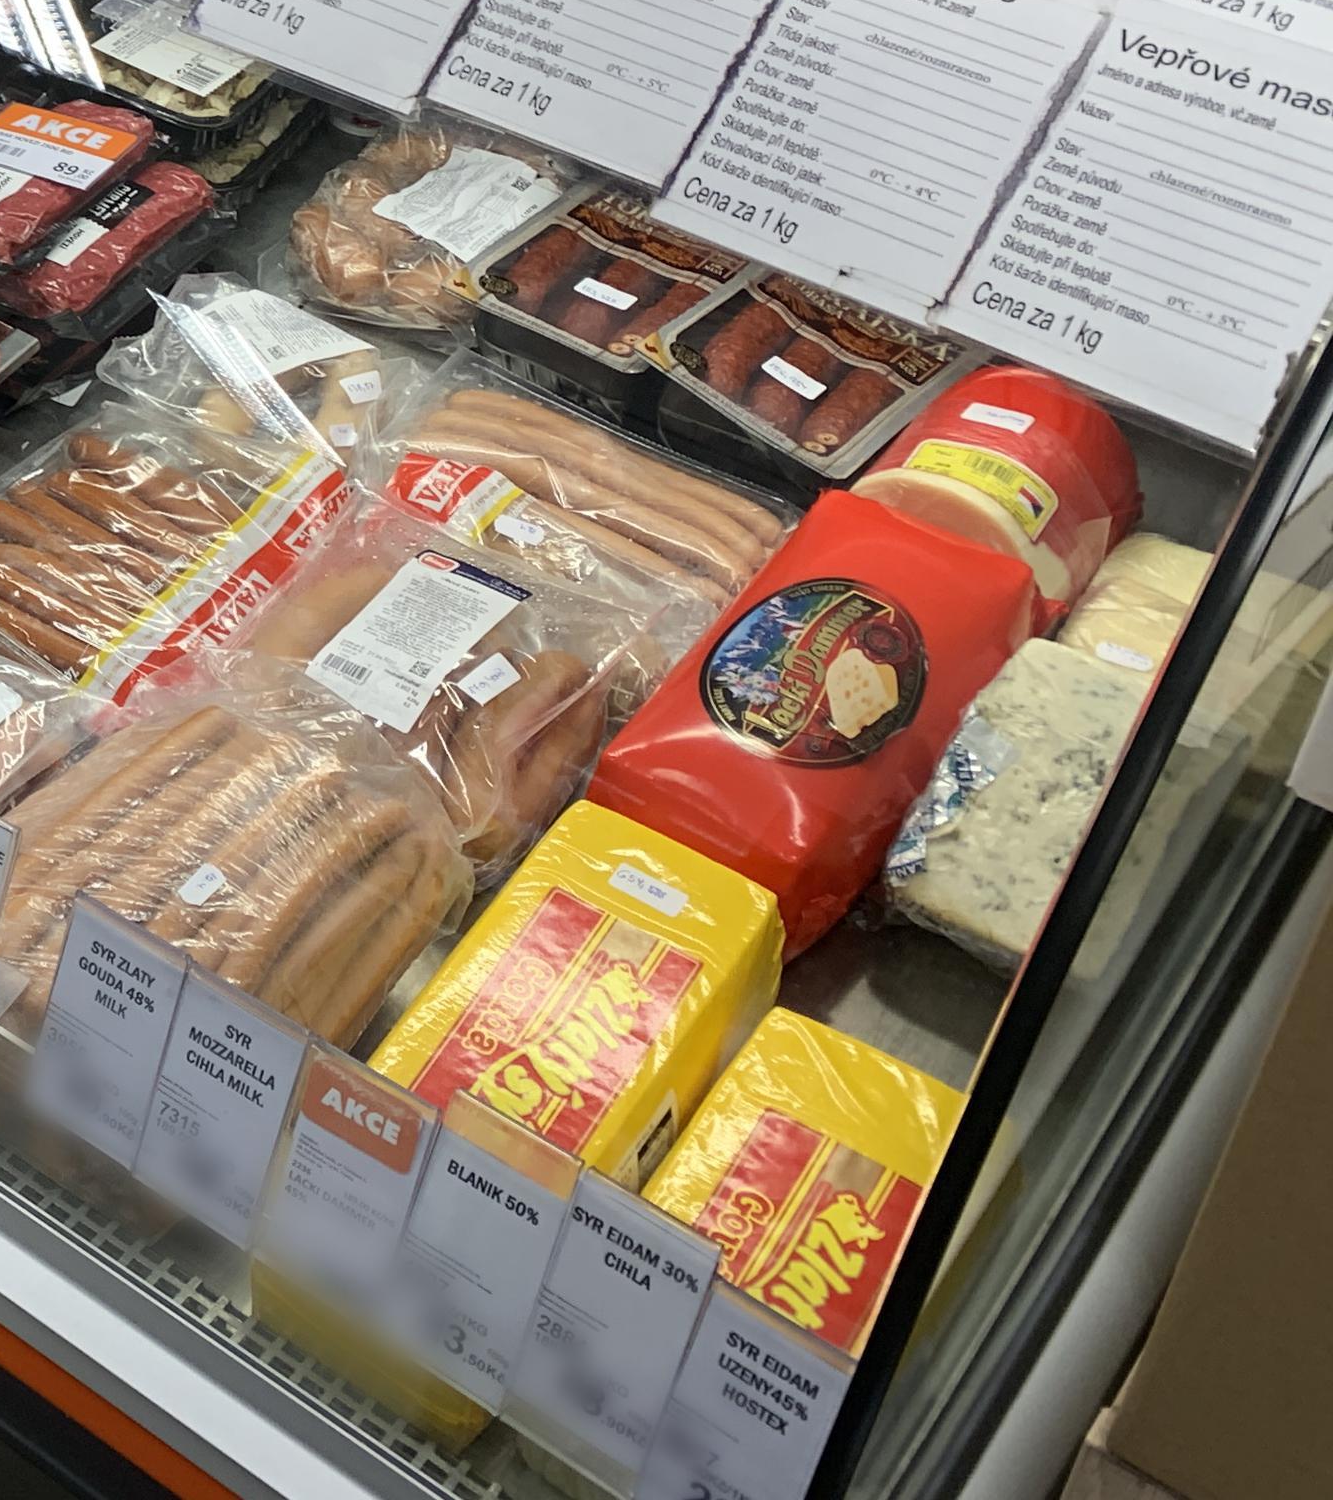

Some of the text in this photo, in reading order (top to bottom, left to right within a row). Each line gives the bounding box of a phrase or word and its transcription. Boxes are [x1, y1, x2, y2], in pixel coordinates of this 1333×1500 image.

[1267, 3, 1295, 31] kg
[763, 41, 794, 63] Země
[786, 6, 991, 84] Stav: chlazené/rozmrazeno
[1119, 28, 1251, 89] Vepřové
[447, 55, 552, 116] Cena za kg
[783, 71, 815, 92] země
[732, 95, 790, 129] Spotřebujte
[786, 95, 818, 116] země
[1076, 100, 1115, 123] Název
[11, 113, 113, 151] AKCE
[710, 132, 771, 165] Schvalovací
[721, 114, 768, 143] Skladujte
[52, 161, 80, 177] 89
[700, 152, 721, 170] Kód
[1043, 156, 1124, 195] Země původu
[1055, 137, 1292, 226] Stav: chlazené/rozmrazeno
[683, 177, 799, 244] Cena za kg
[972, 281, 1104, 354] Cena za kg
[78, 955, 156, 1014] GOUDA 48%
[90, 940, 156, 989] SYR ZLATY
[94, 988, 128, 1020] MILK
[188, 1026, 276, 1091] MOZZARELLA
[224, 1023, 253, 1051] SYR
[185, 1049, 265, 1108] CIHLA MILK.
[156, 1100, 201, 1138] 7315
[320, 1086, 402, 1146] AKCE
[446, 1158, 541, 1227] BLANIK 50%
[571, 1205, 701, 1295] SYR EIDAM 30%
[603, 1251, 653, 1293] CIHLA
[717, 1351, 810, 1423] UZENY45%
[725, 1330, 821, 1401] SYR EIDAM
[721, 1381, 791, 1437] HOSTEX
